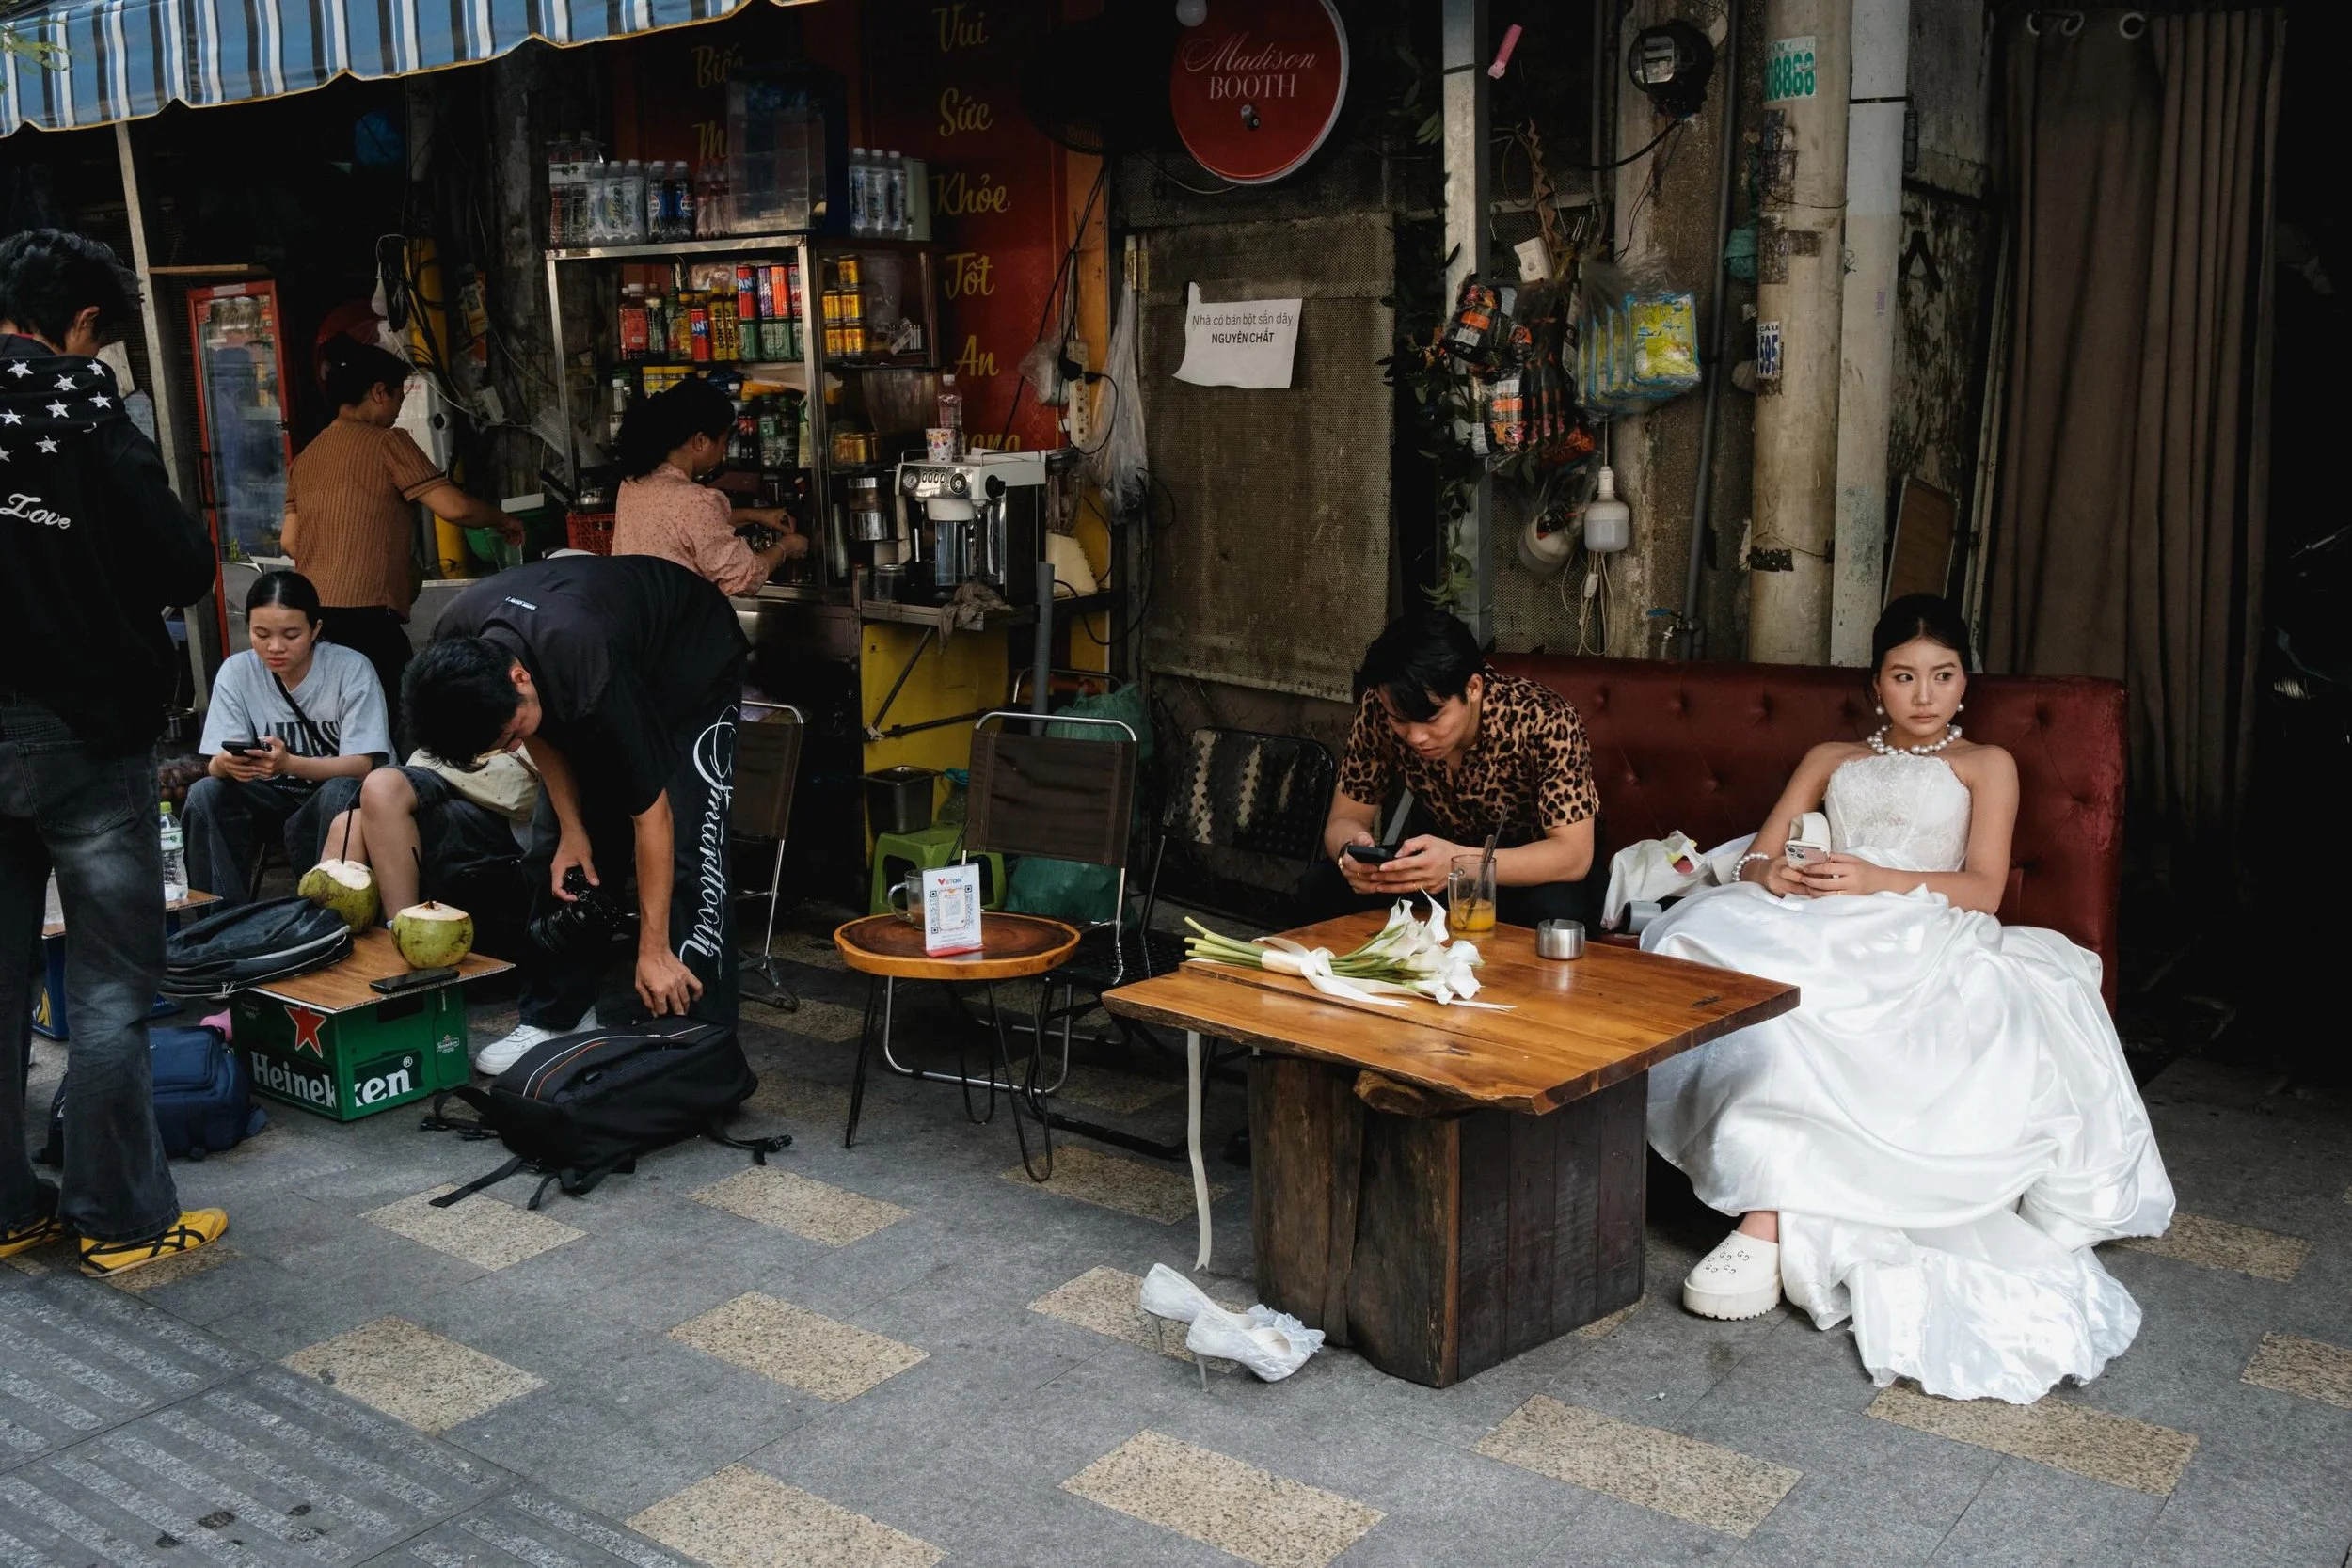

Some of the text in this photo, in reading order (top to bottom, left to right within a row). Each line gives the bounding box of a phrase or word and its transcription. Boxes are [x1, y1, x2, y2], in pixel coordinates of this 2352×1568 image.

[931, 3, 990, 54] Vui
[1182, 31, 1317, 72] Madison
[1210, 73, 1296, 100] BOOTH
[938, 87, 993, 138] Sức
[928, 171, 1011, 216] Khỏe
[945, 251, 995, 300] Tốt
[1211, 327, 1275, 344] NGUYÊN CHẤT
[1213, 314, 1224, 325] có
[1243, 313, 1256, 327] bột
[954, 334, 1000, 378] An
[0, 493, 72, 530] Love
